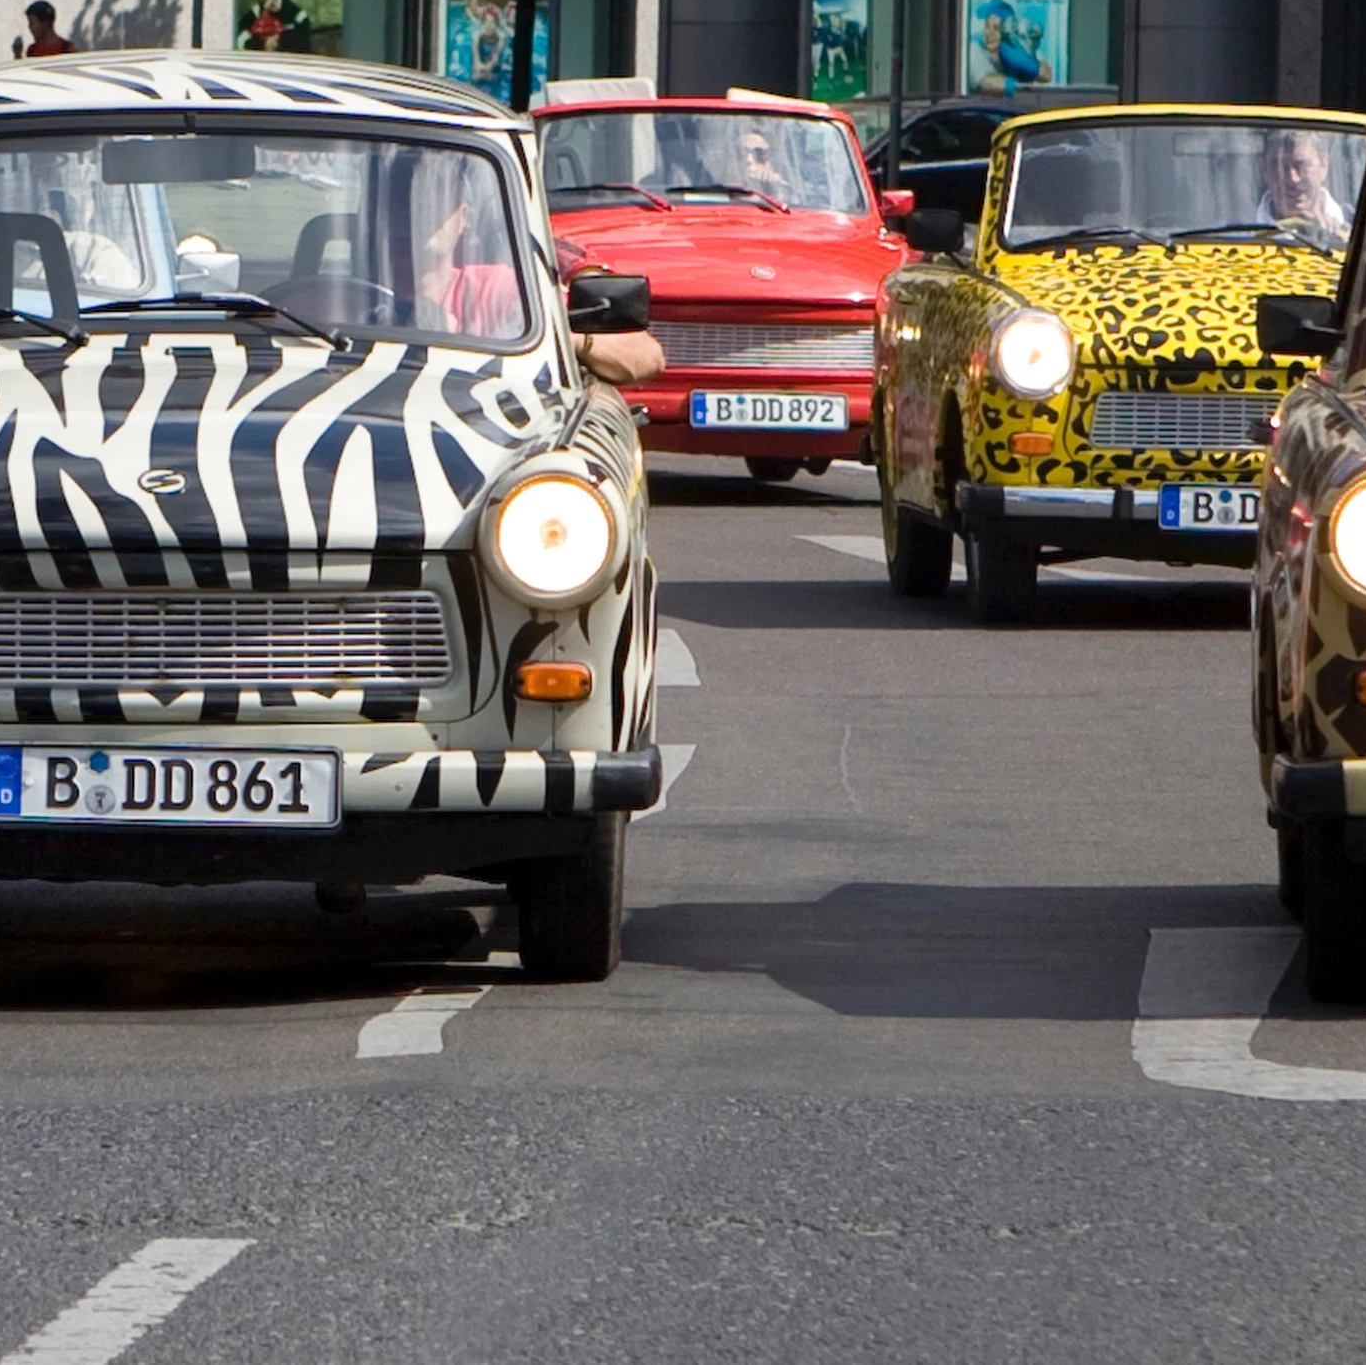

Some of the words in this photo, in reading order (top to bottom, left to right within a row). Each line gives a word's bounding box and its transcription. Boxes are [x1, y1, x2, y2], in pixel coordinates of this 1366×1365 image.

[717, 398, 732, 421] B
[752, 399, 783, 422] DD
[789, 399, 834, 422] 892
[1194, 492, 1214, 522] B
[0, 788, 13, 804] D
[47, 757, 80, 809] B
[122, 758, 194, 811] DD
[207, 760, 310, 814] 861
